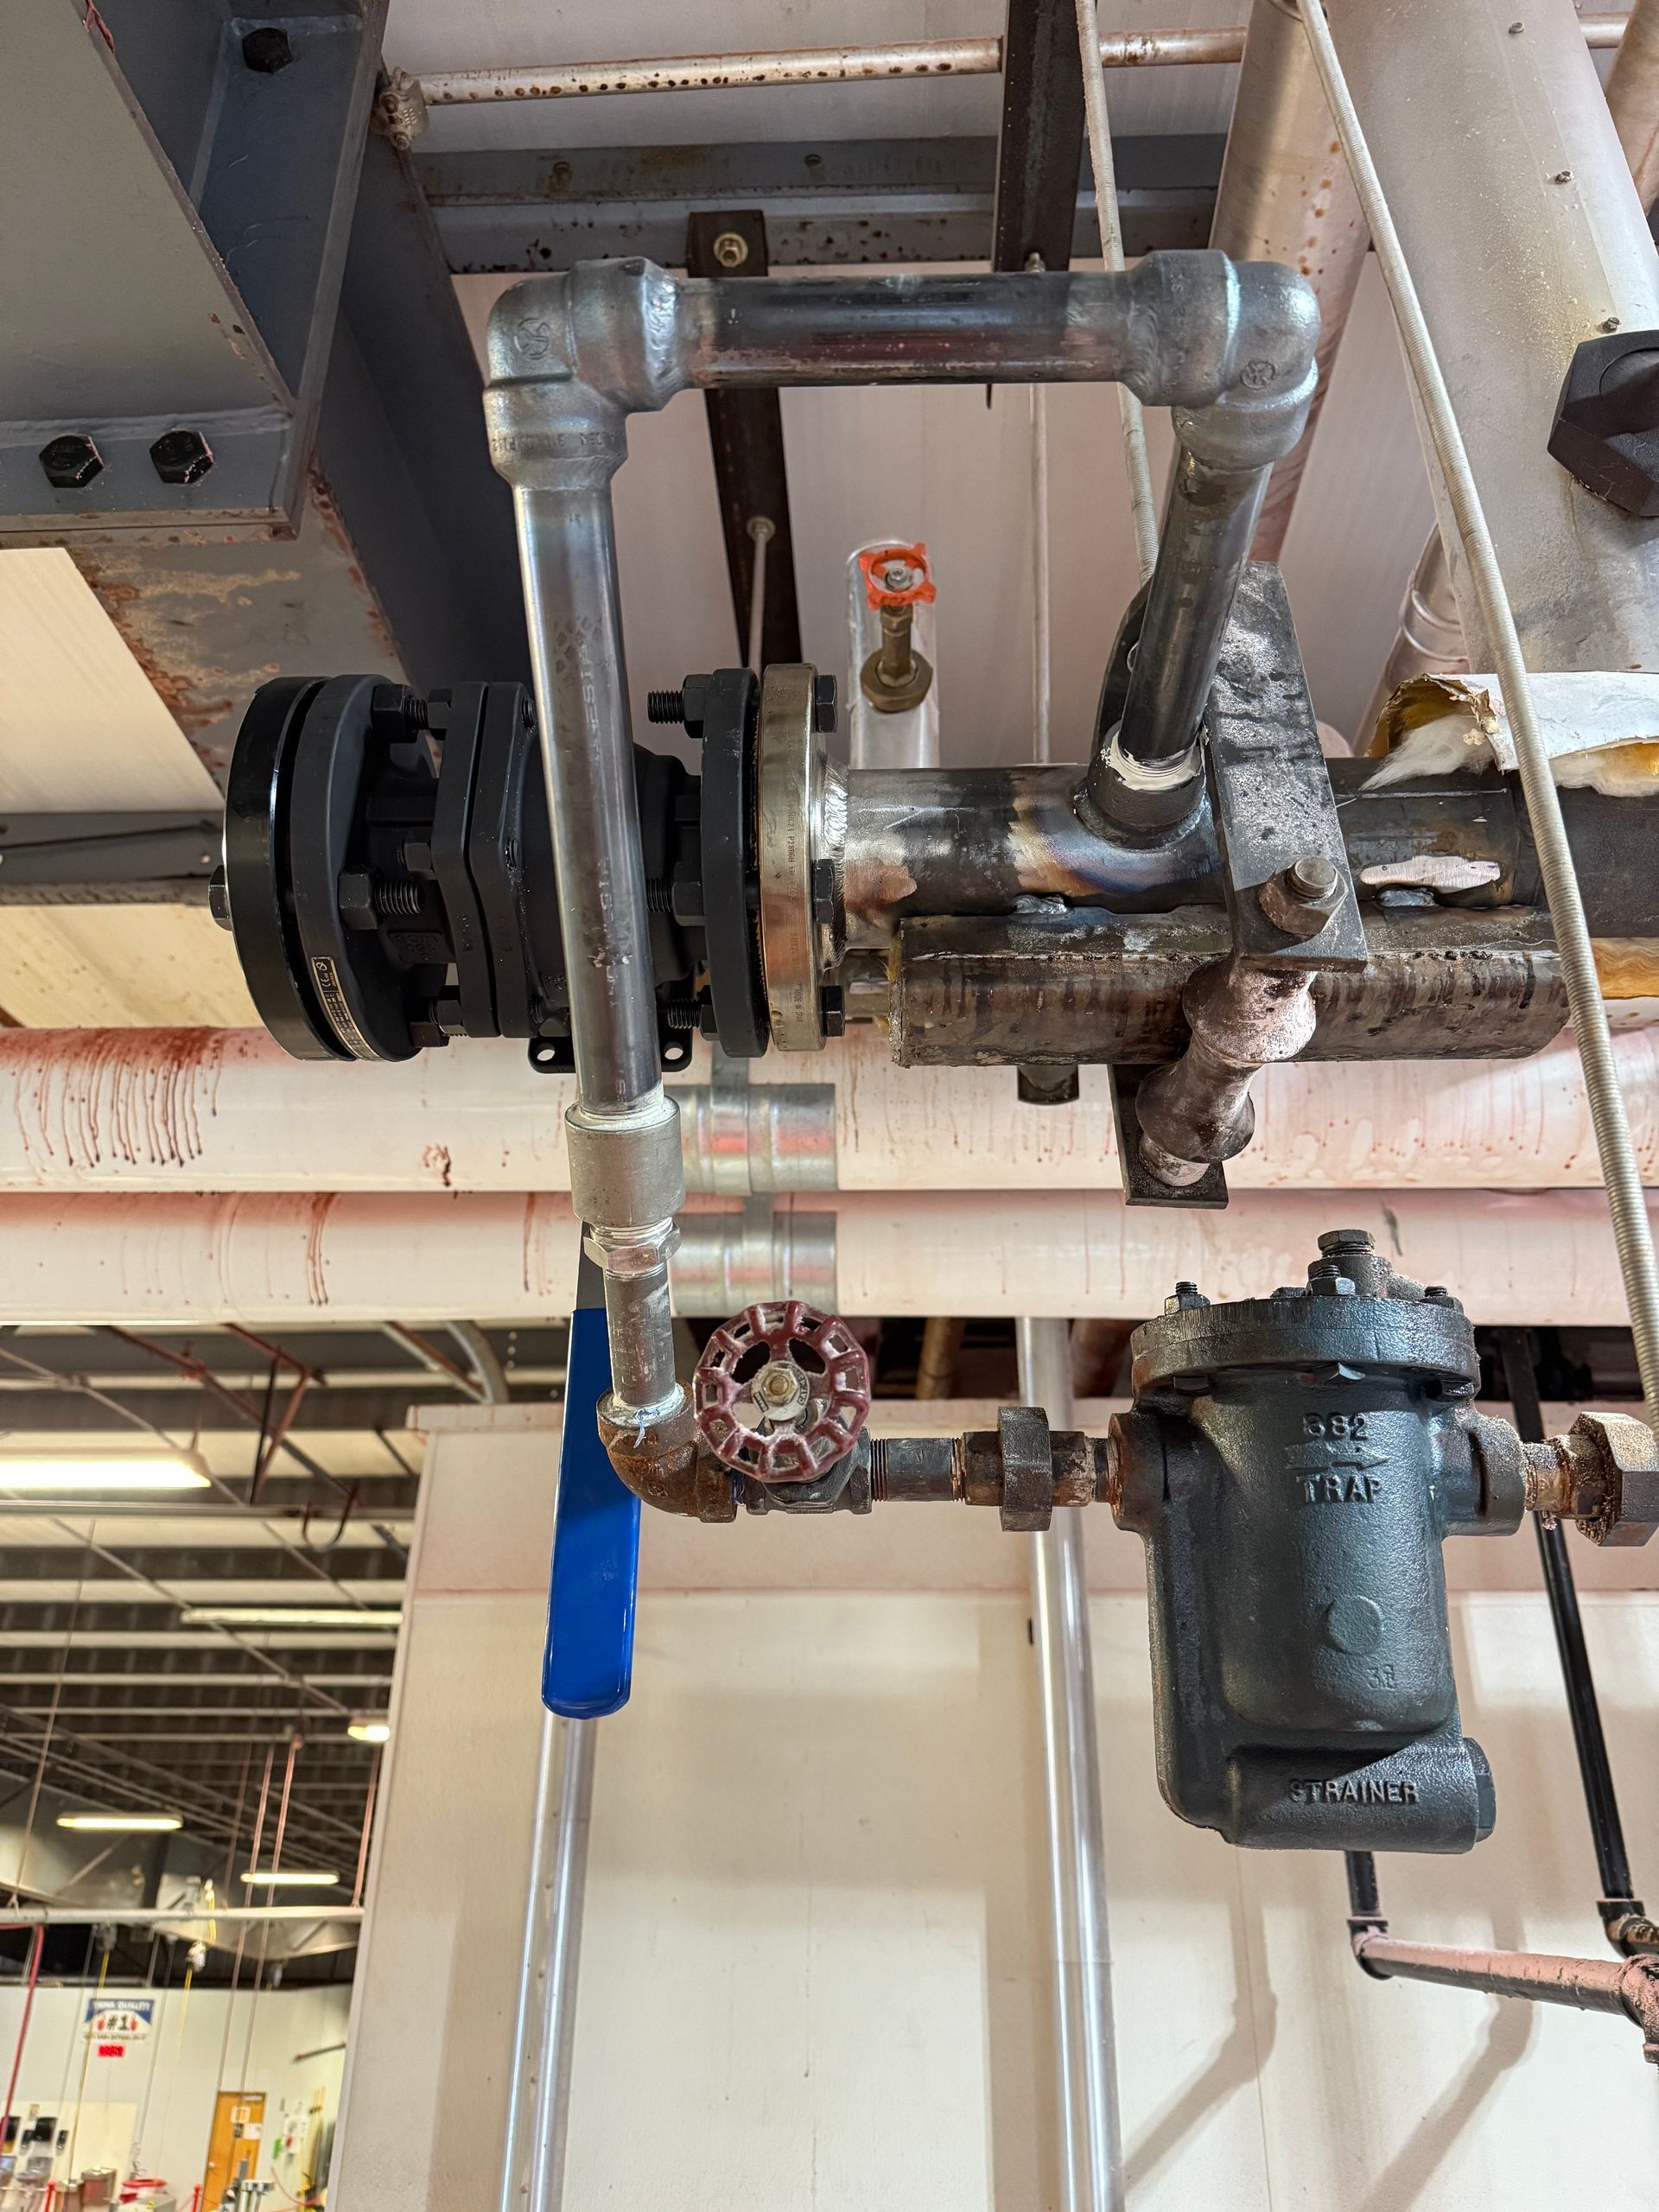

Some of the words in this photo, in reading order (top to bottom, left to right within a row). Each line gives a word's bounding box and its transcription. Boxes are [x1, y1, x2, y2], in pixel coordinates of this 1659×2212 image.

[1301, 1412, 1368, 1440] 882
[1295, 1473, 1382, 1503] TRAP
[1288, 1778, 1421, 1804] STRAINER
[106, 2014, 129, 2031] #1
